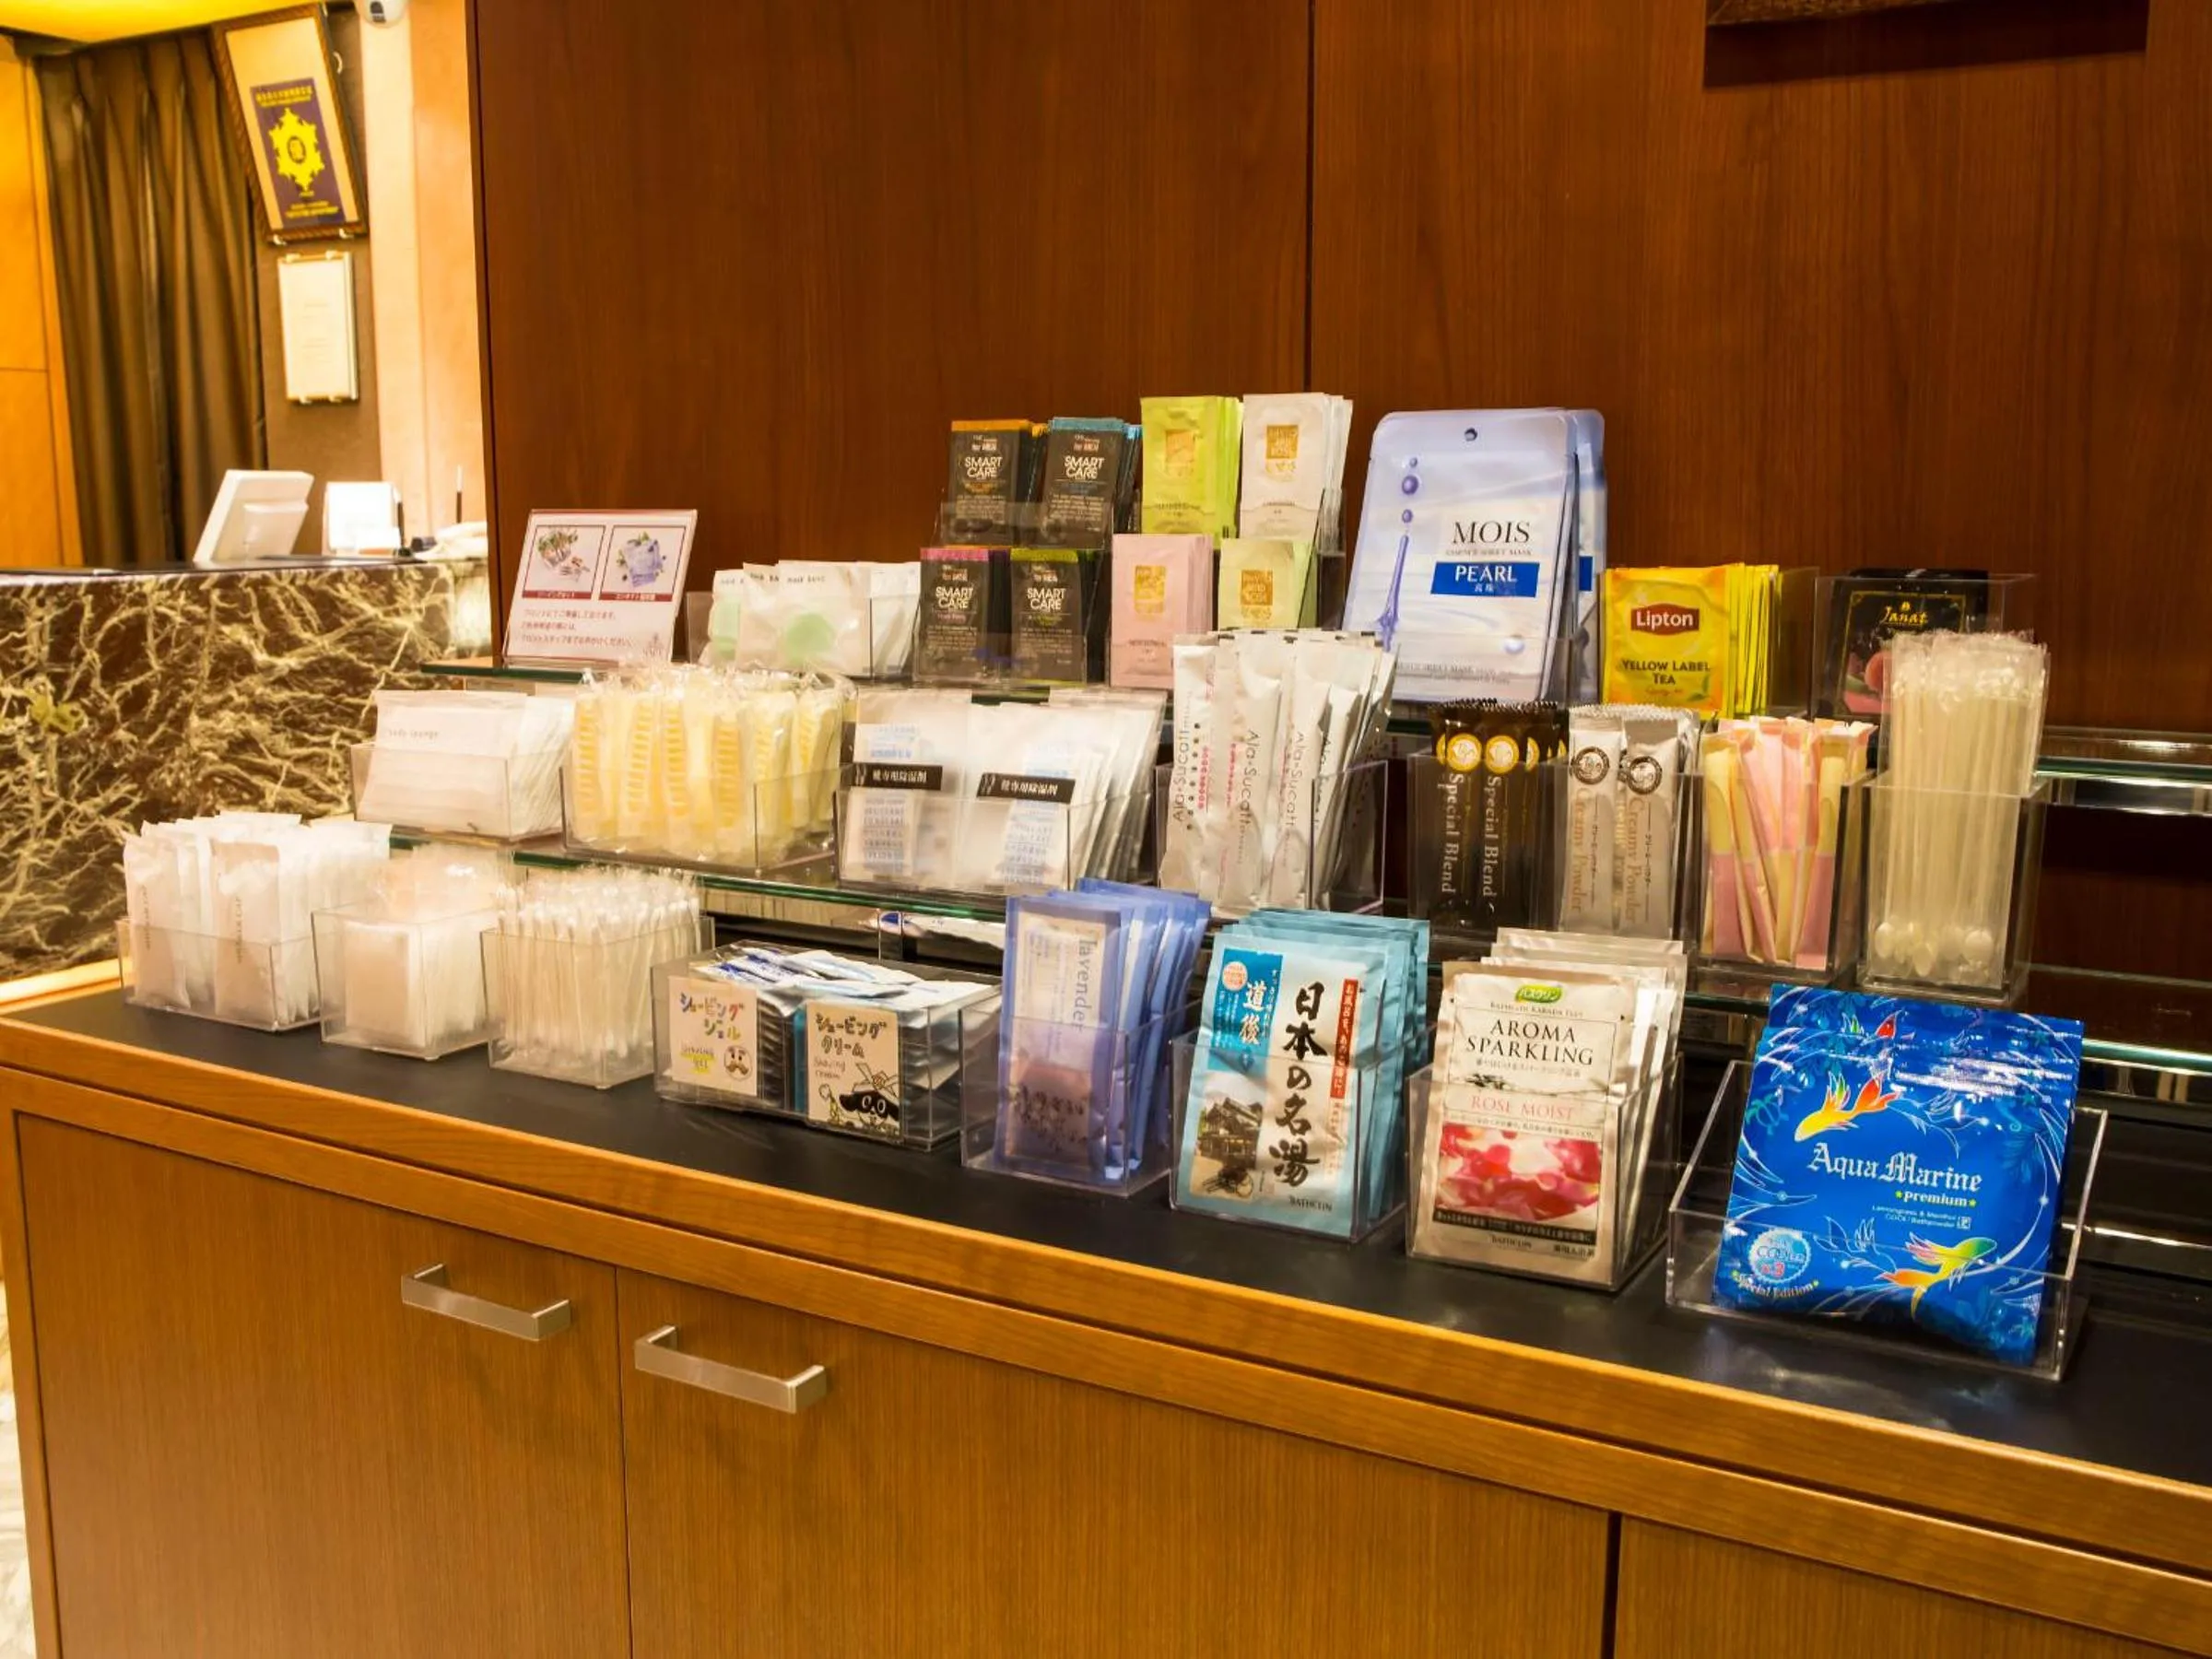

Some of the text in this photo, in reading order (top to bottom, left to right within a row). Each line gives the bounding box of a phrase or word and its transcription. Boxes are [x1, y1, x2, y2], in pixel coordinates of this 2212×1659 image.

[965, 456, 1003, 468] SMART
[967, 466, 997, 478] CARE
[1064, 455, 1104, 469] SMART
[1065, 466, 1098, 479] CARE
[1453, 521, 1530, 544] MOIS
[1455, 565, 1517, 582] PEARL
[935, 586, 974, 599] SMART
[938, 598, 969, 609] CARE
[1027, 587, 1066, 599] SMART
[1030, 599, 1062, 610] CARE
[1636, 611, 1694, 631] Lipton
[1622, 660, 1711, 672] YELLOW LABEL
[1653, 673, 1676, 685] TEA
[1438, 773, 1465, 836] Special
[1571, 788, 1592, 848] Creamy
[1482, 776, 1502, 897] Special Blend
[1441, 842, 1459, 893] Blend
[1626, 797, 1646, 924] Creamy Powder
[1571, 854, 1588, 912] Powder
[1071, 939, 1098, 1031] lavender
[1239, 981, 1267, 1044] 道後
[1490, 1019, 1575, 1042] AROMA
[821, 1035, 865, 1059] クリーム
[1466, 1034, 1594, 1065] SPARKLING
[1269, 982, 1327, 1186] 日本の名湯
[1471, 1095, 1573, 1121] ROSE MOIST
[1807, 1142, 1983, 1193] Aqua Marine
[1903, 1191, 1968, 1207] premium
